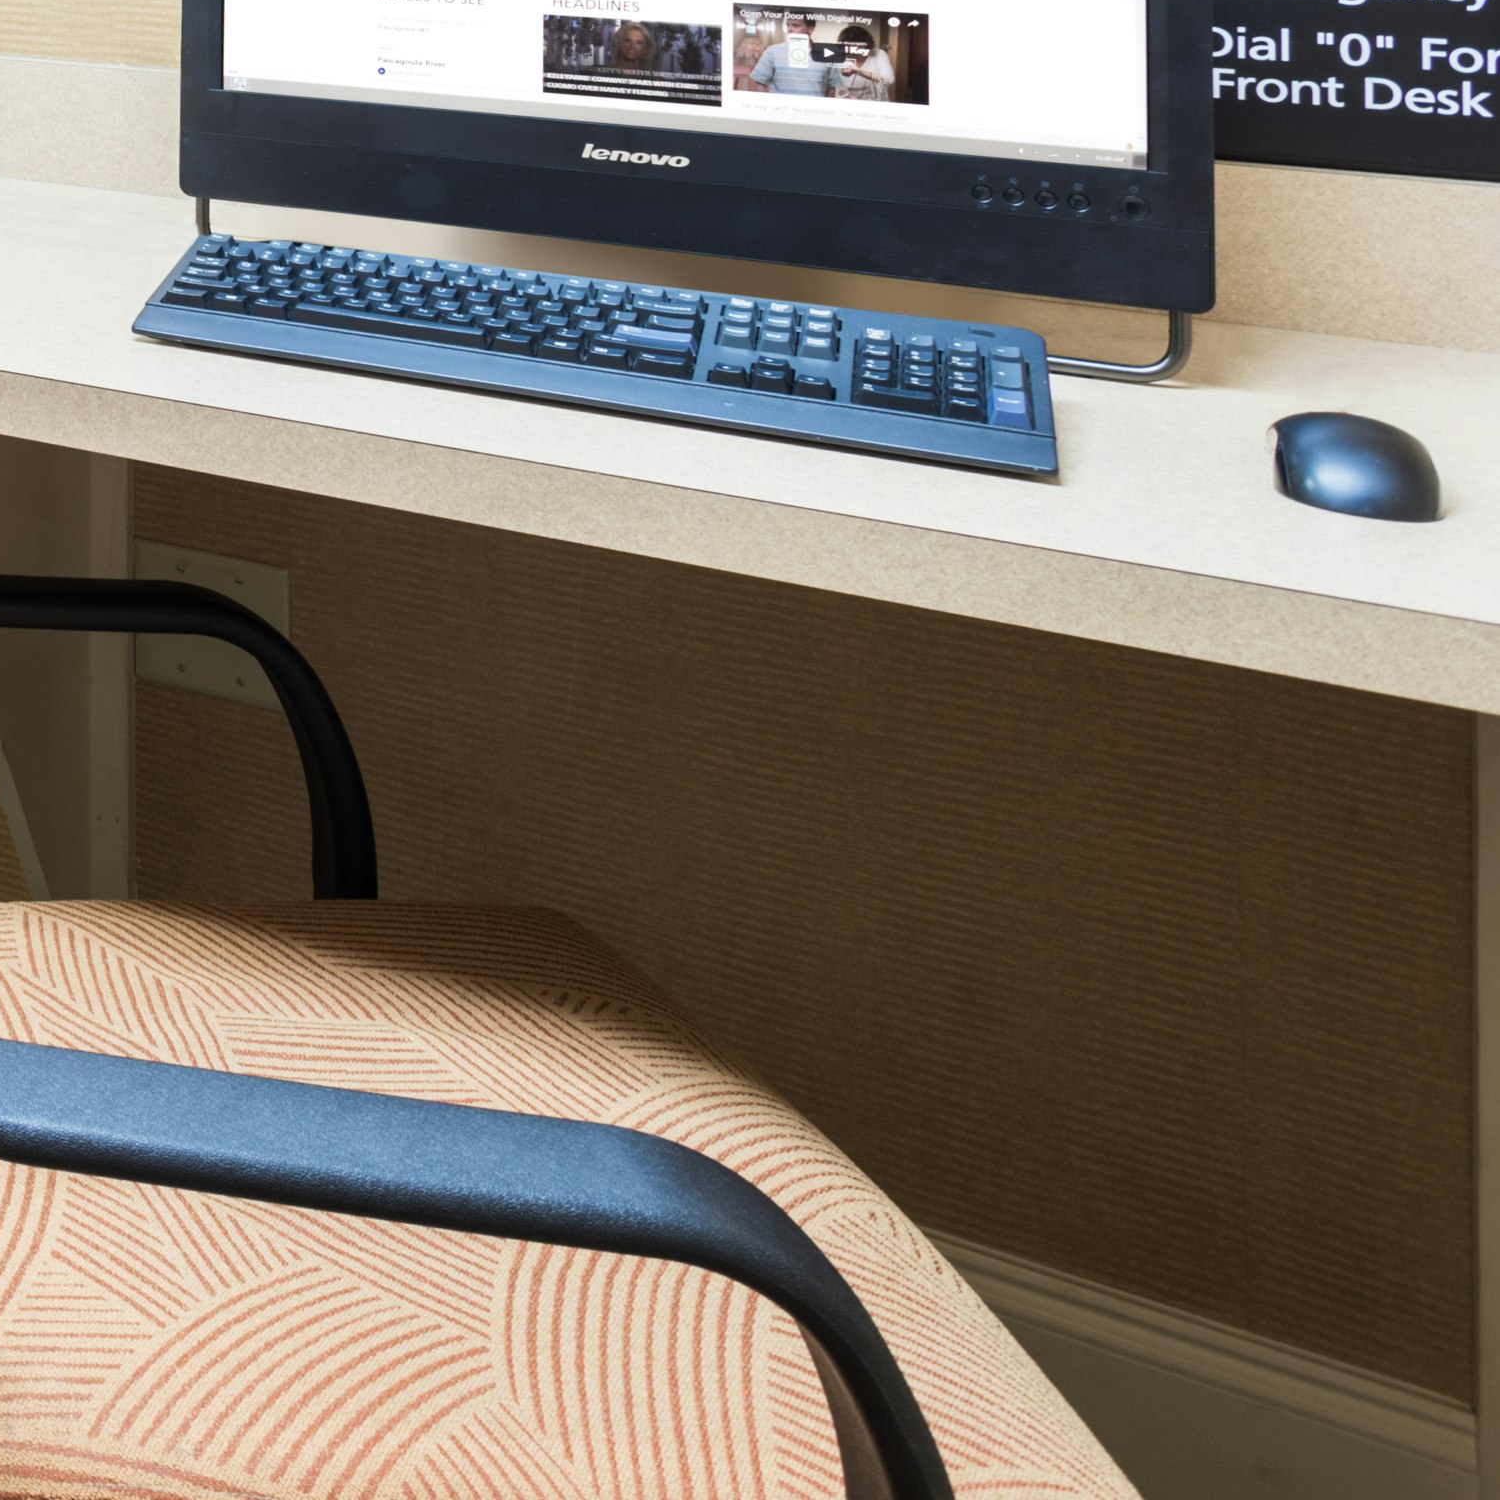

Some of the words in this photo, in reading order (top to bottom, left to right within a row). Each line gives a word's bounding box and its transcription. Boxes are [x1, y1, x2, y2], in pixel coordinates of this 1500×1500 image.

[740, 9, 761, 19] Open
[763, 11, 782, 19] Your
[785, 12, 804, 20] Door
[806, 13, 825, 21] With
[827, 14, 854, 25] Digital
[856, 16, 872, 25] Key
[1316, 31, 1394, 67] "0"
[547, 82, 577, 90] CUOMO
[579, 84, 599, 92] OVER
[600, 86, 631, 95] HARVEY
[633, 88, 668, 97] FUNDING
[592, 76, 627, 84] CONWAY
[1212, 68, 1345, 107] Front
[1364, 77, 1493, 118] Desk
[582, 143, 690, 168] lenovo
